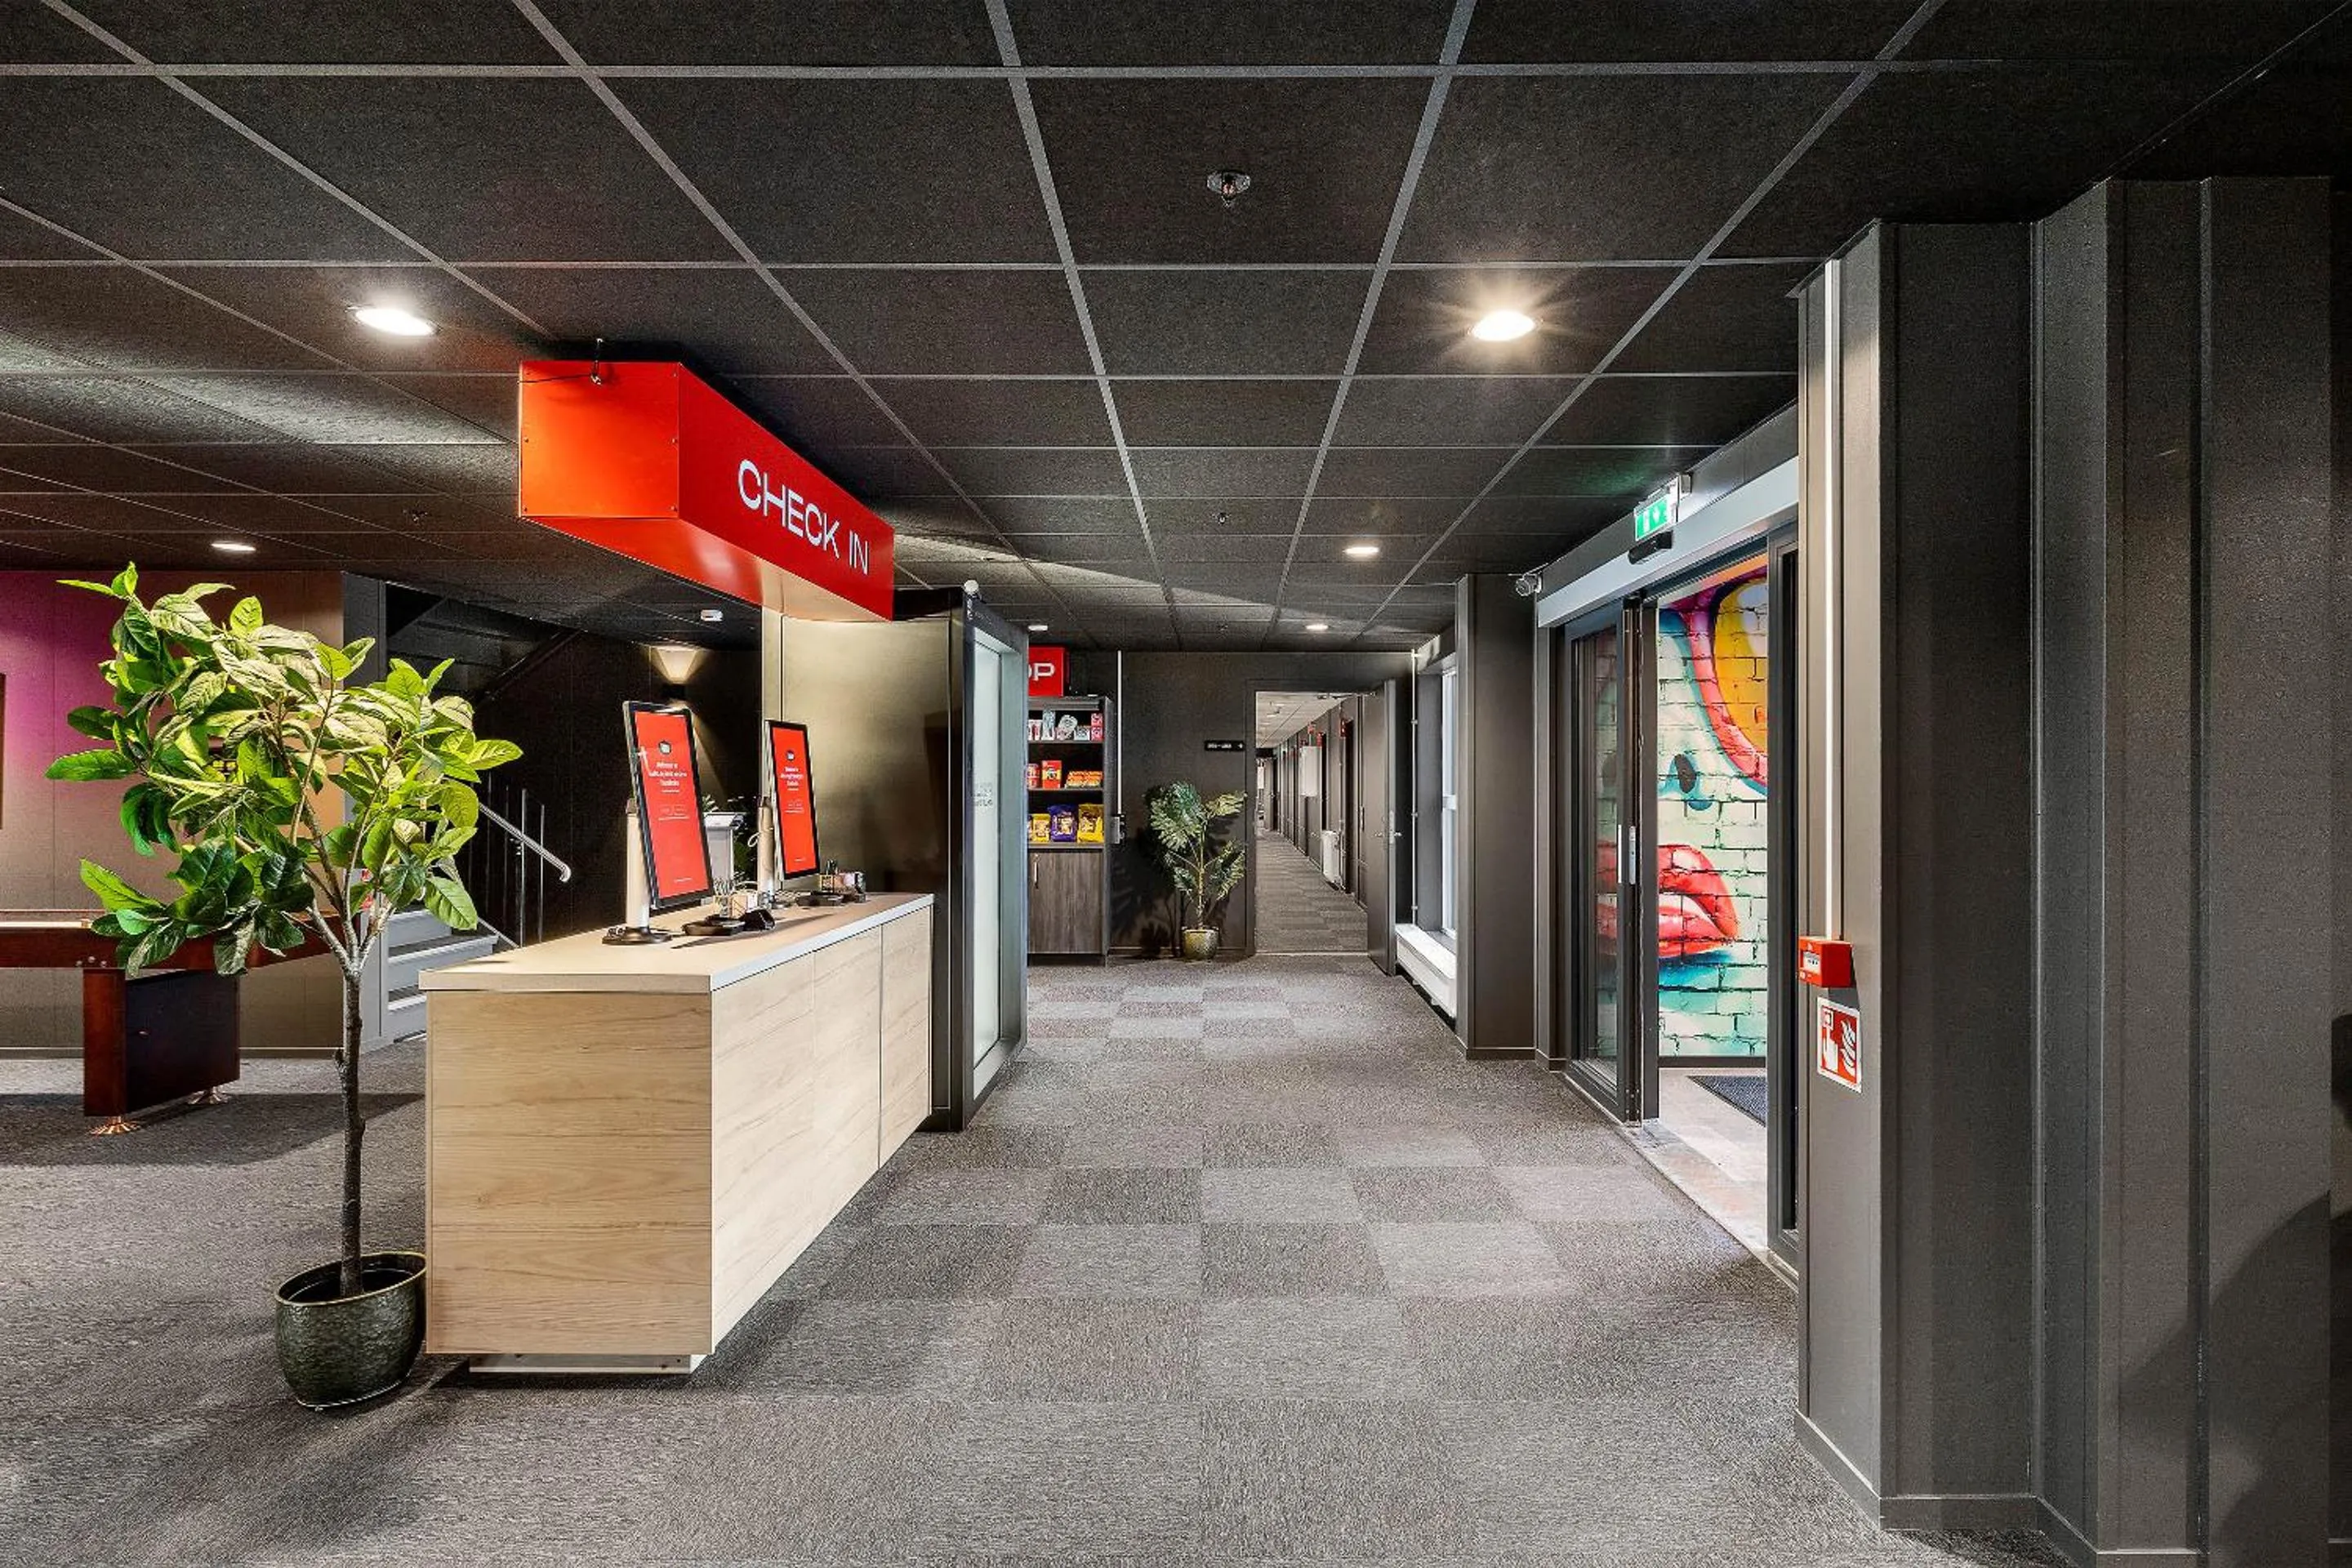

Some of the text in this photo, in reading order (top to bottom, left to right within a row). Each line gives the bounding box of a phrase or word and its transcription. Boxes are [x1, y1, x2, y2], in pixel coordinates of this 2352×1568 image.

[738, 459, 868, 575] CHECK IN
[1028, 662, 1056, 681] P
